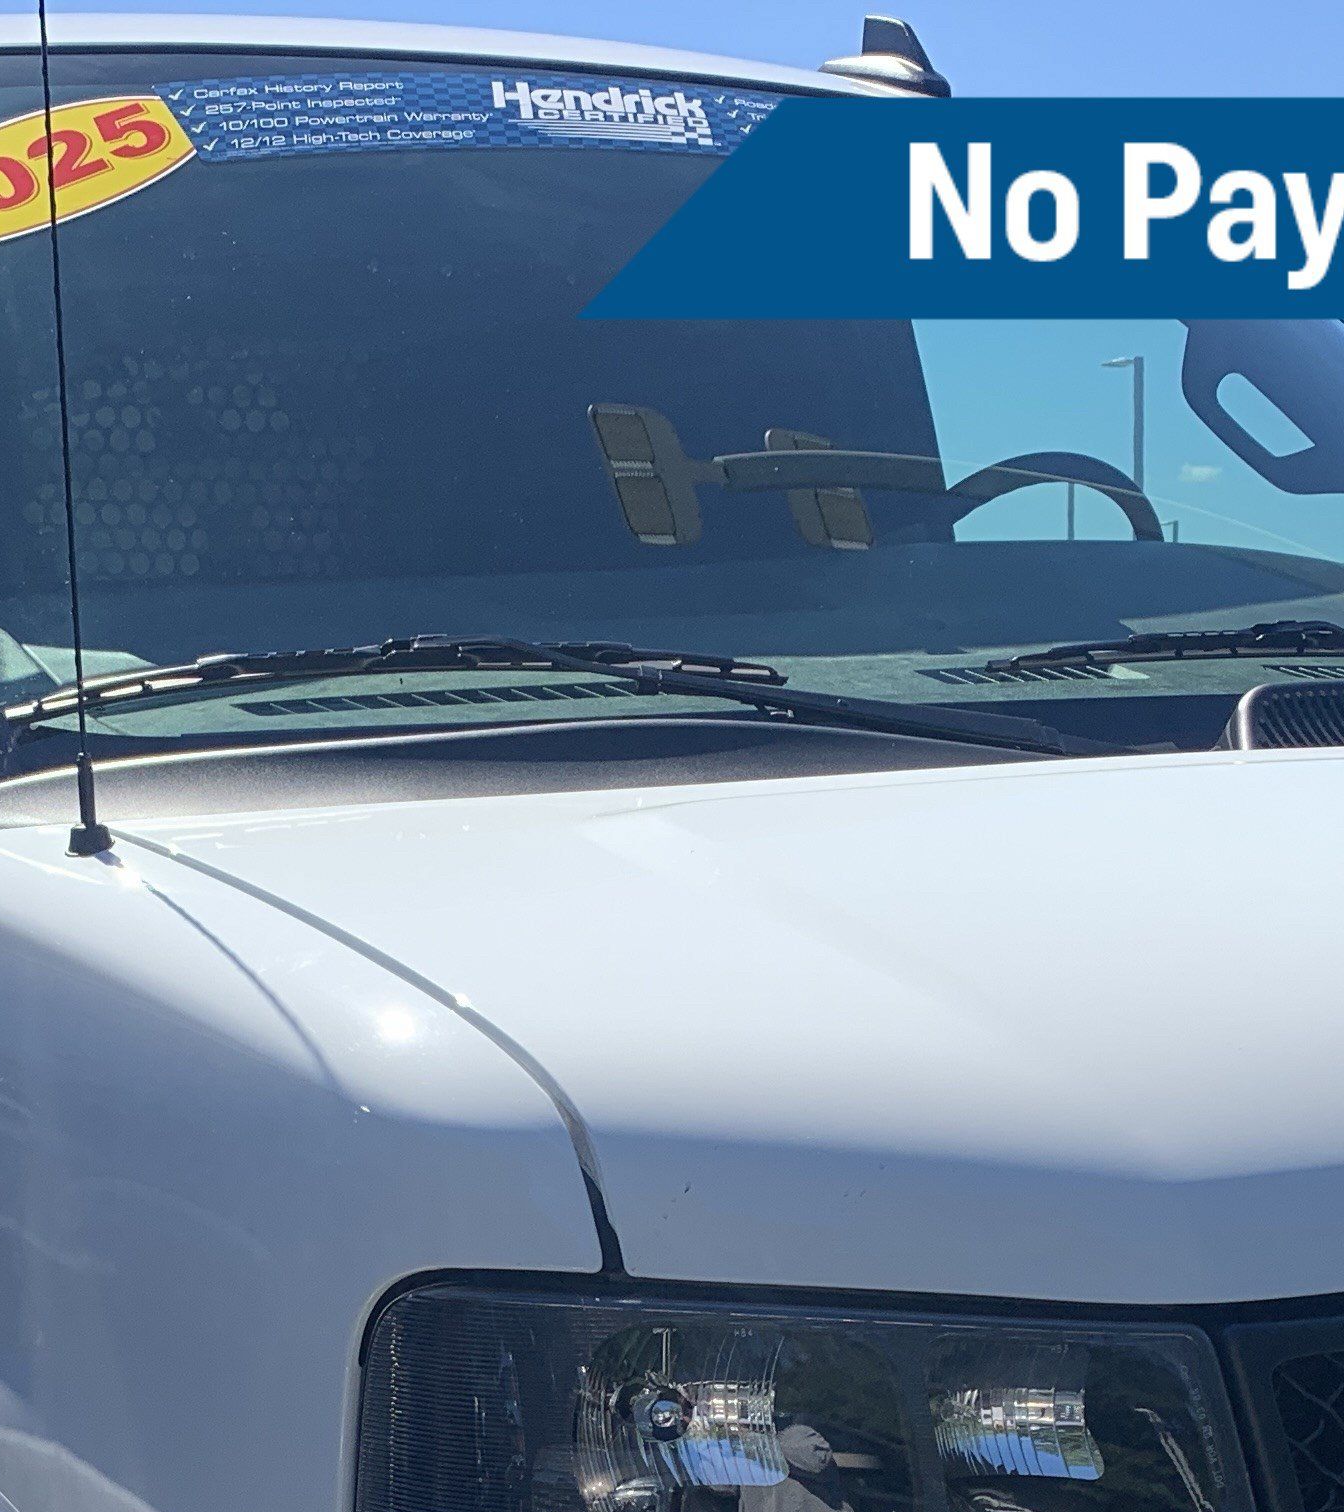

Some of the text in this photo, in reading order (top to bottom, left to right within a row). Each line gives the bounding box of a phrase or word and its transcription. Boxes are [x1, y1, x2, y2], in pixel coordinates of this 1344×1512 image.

[194, 81, 404, 99] Carfax History Report
[205, 99, 301, 115] 257-Point
[492, 81, 706, 120] Hendrick
[734, 98, 775, 110] Road
[219, 117, 289, 132] 10/100
[295, 112, 399, 127] Powertrain
[538, 108, 709, 128] CERTIFIED
[230, 135, 286, 149] 12/12
[293, 131, 381, 145] High-Tech
